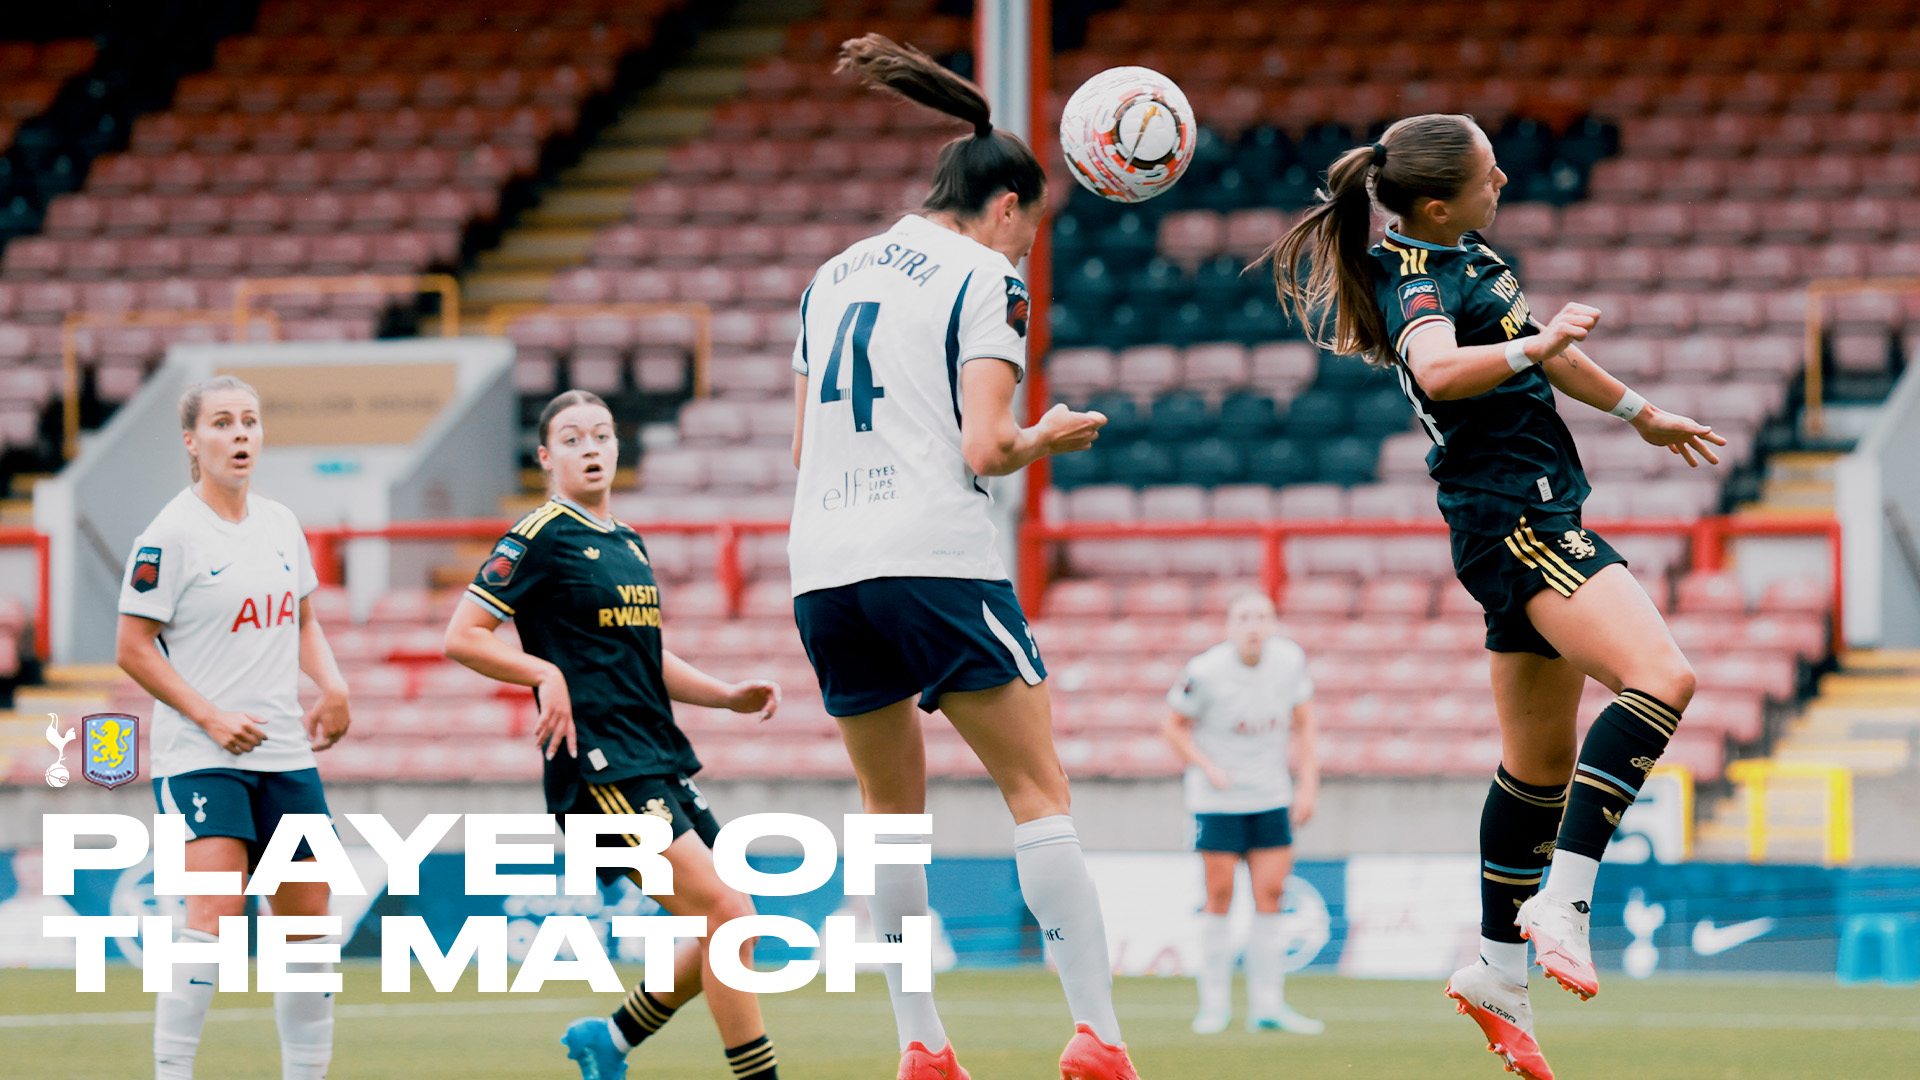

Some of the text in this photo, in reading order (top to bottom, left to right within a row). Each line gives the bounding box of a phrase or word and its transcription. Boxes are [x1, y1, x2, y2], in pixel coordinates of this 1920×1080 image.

[1491, 269, 1520, 303] VISIT
[820, 302, 885, 432] 4
[616, 584, 658, 605] VISIT
[231, 591, 294, 632] AIA
[598, 606, 662, 629] RWAND
[884, 933, 903, 944] TH
[1043, 927, 1065, 942] HFC
[1481, 1000, 1517, 1024] ULTRA
